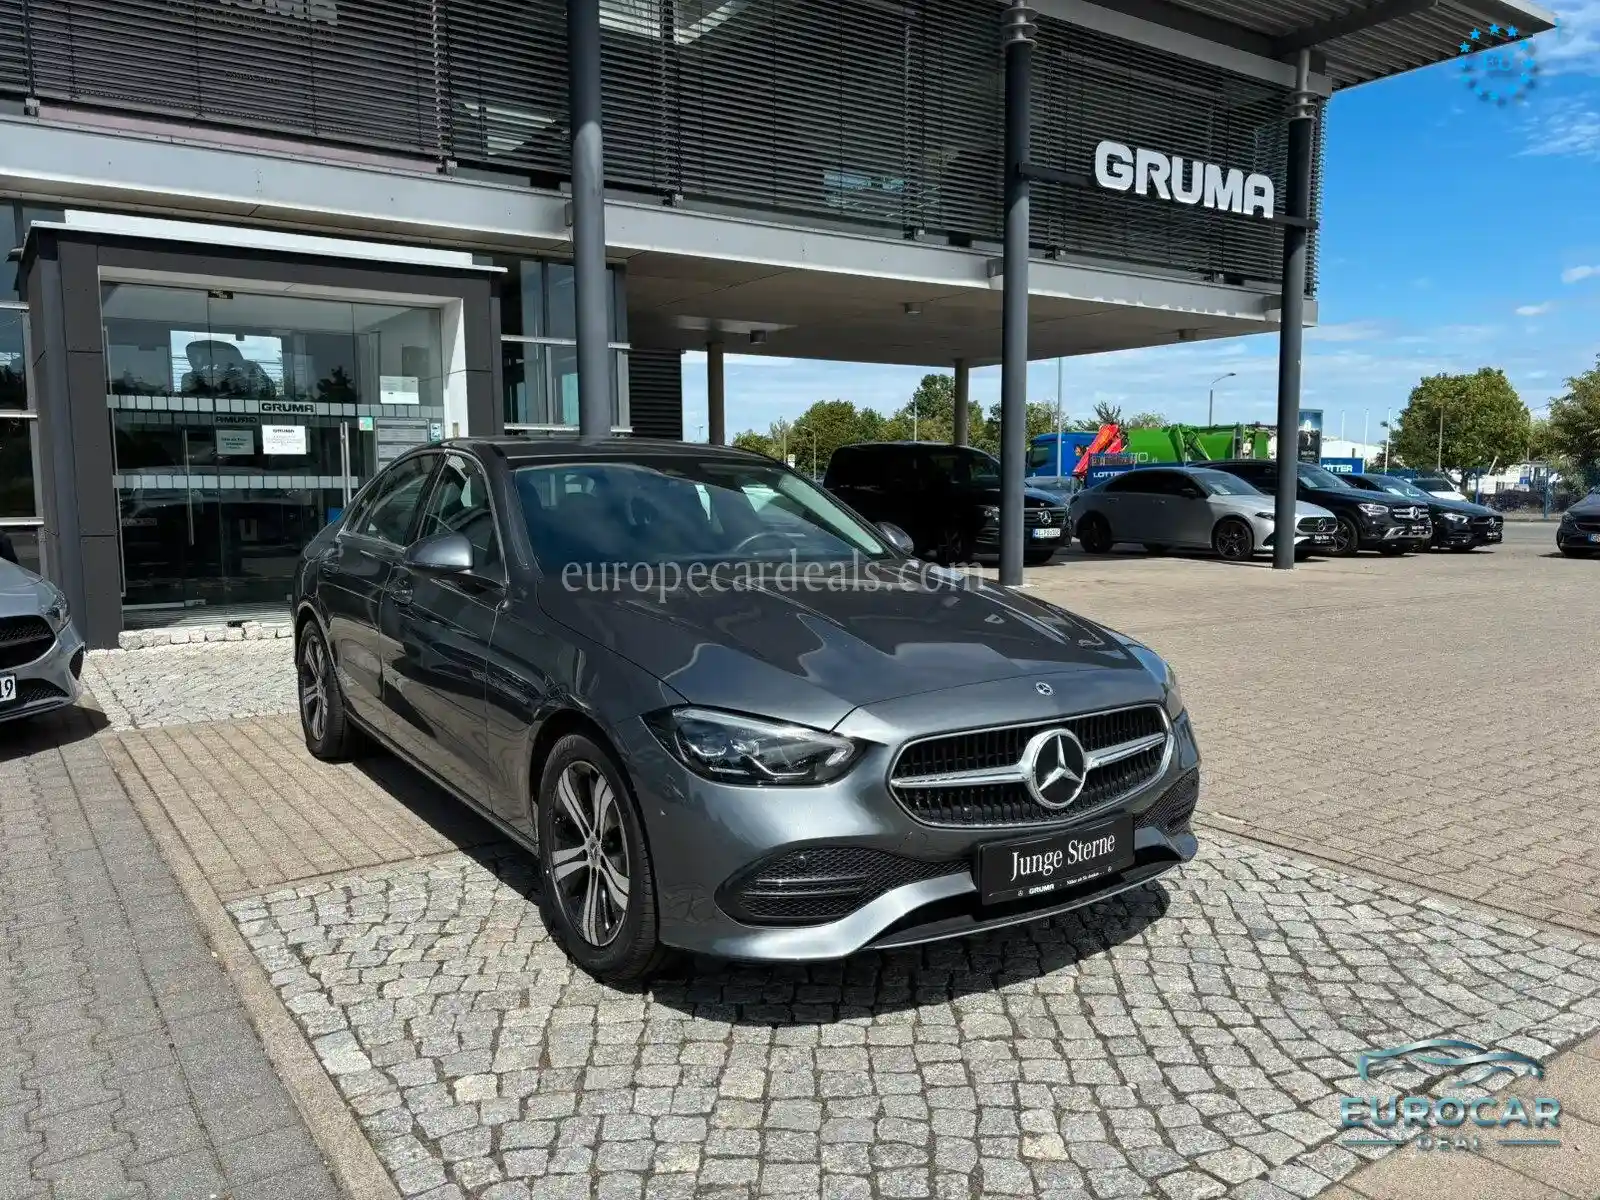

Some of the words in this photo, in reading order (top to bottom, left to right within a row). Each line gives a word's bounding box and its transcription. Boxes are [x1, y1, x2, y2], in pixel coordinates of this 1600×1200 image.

[1095, 140, 1275, 219] GRUMA
[262, 403, 315, 413] GRUMA
[1010, 851, 1063, 882] Junge
[1067, 834, 1116, 866] Sterne
[1028, 883, 1055, 895] GRUMA
